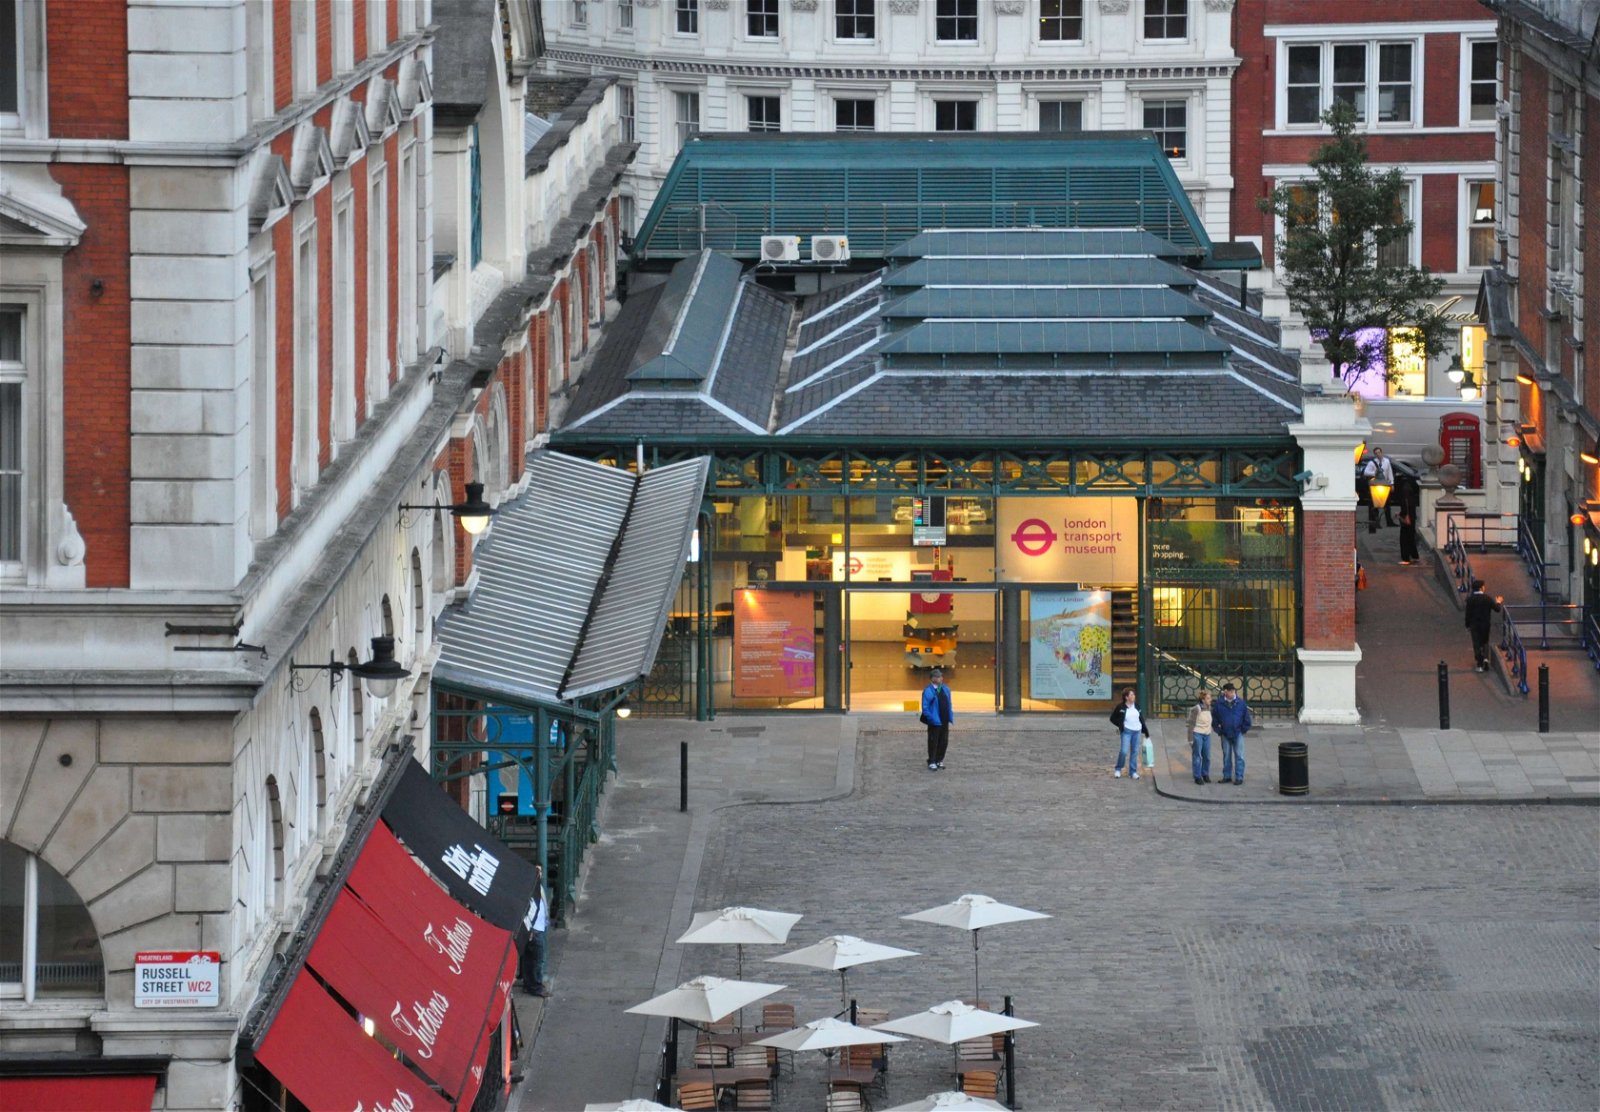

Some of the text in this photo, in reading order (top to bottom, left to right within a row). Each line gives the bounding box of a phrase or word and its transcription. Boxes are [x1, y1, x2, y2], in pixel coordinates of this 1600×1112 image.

[1064, 518, 1107, 529] london
[1064, 532, 1122, 543] transport
[1064, 545, 1116, 554] museum
[424, 917, 474, 975] Tuttons
[142, 968, 191, 979] RUSSELL
[142, 981, 212, 993] STREET WC2
[391, 990, 449, 1059] Tuttons
